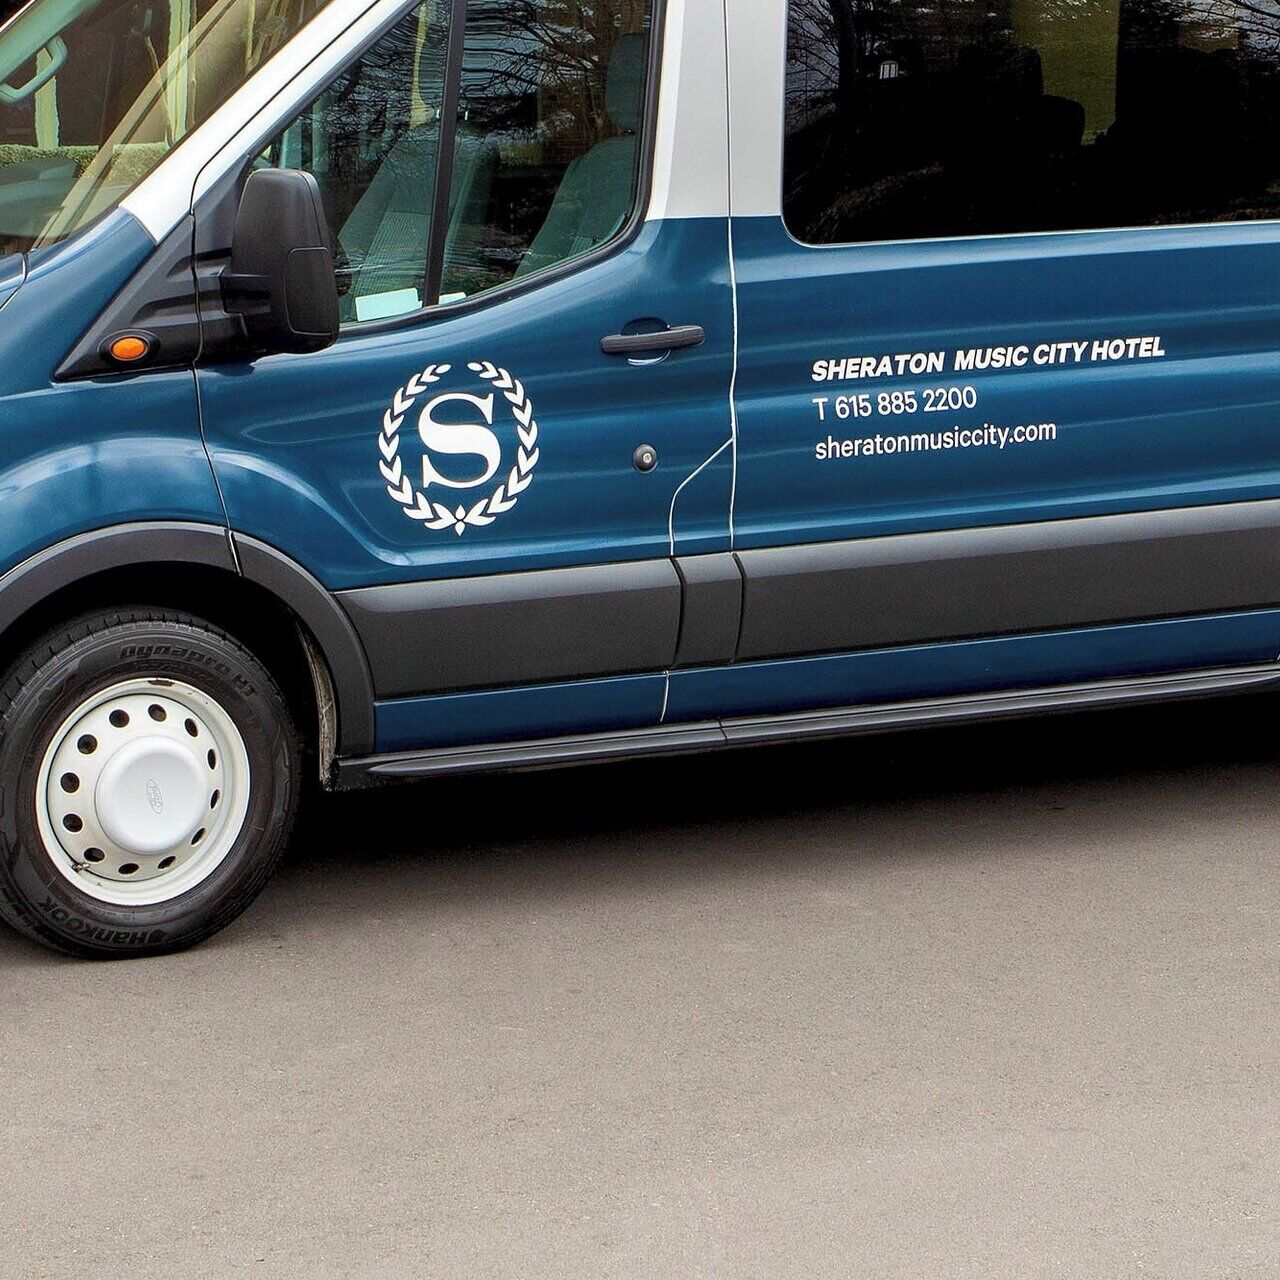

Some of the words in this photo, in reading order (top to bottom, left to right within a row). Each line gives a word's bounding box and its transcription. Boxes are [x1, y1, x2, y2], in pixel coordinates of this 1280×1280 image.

[812, 352, 945, 381] SHERATON
[954, 346, 1030, 371] MUSIC
[1033, 341, 1089, 365] CITY
[1091, 336, 1165, 361] HOTEL
[812, 397, 828, 420] T
[835, 394, 872, 419] 615
[877, 390, 918, 416] 885
[922, 386, 977, 412] 2200
[418, 392, 501, 489] S
[815, 422, 1057, 460] sheratonmusiccity.com
